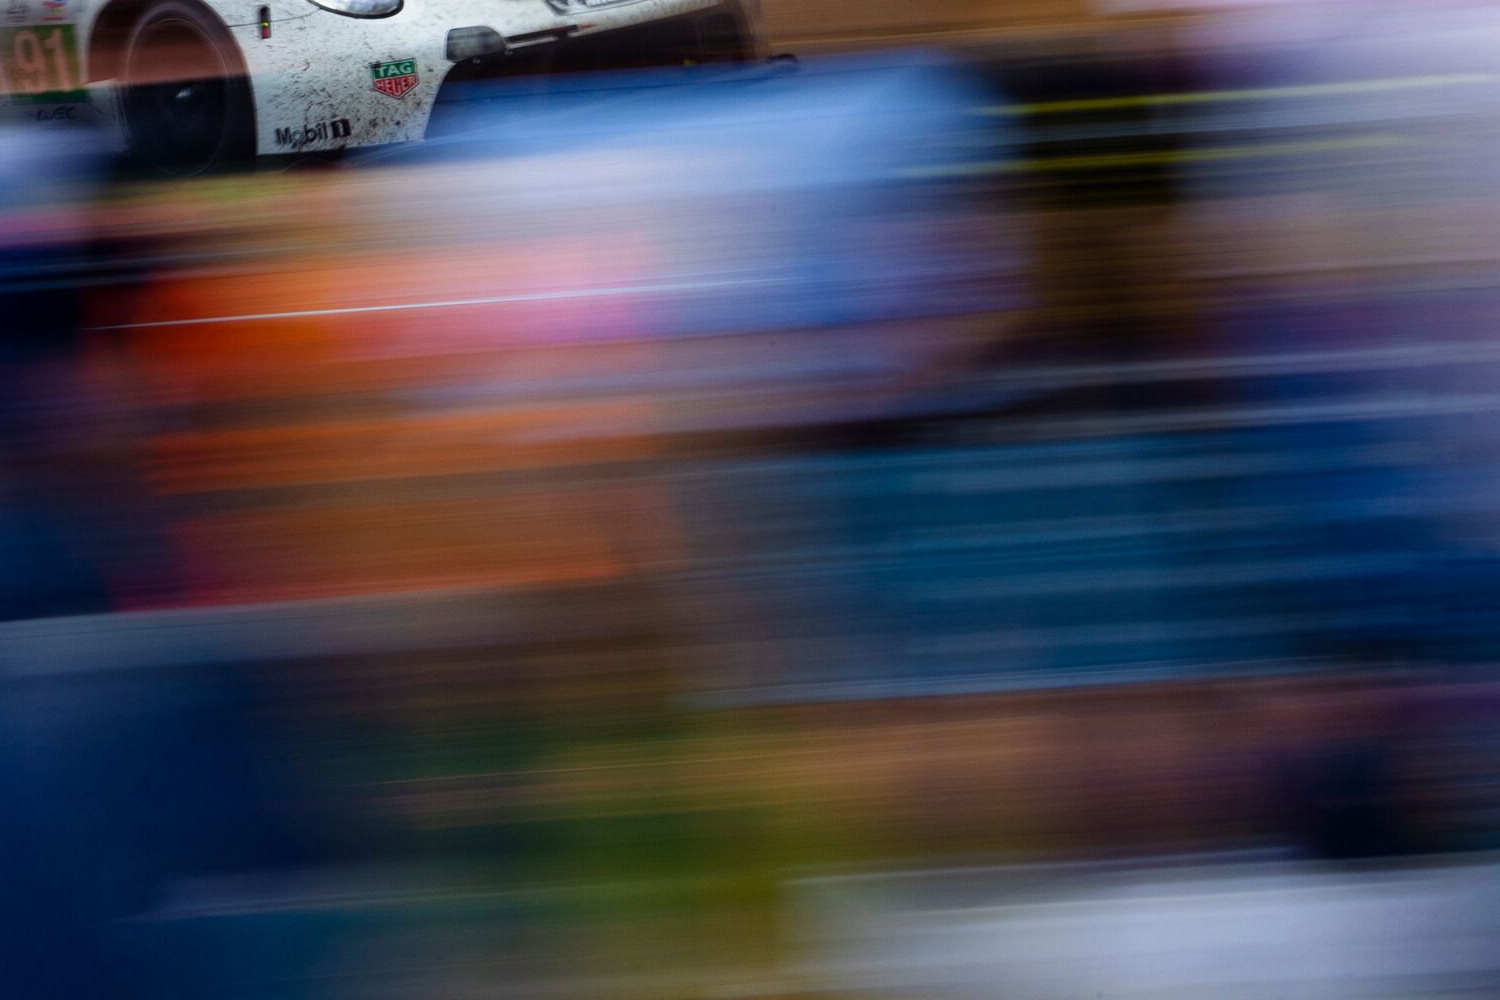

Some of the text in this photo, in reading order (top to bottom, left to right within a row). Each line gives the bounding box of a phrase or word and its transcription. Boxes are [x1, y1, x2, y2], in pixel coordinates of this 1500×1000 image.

[12, 27, 73, 94] 91
[377, 62, 413, 77] TAG
[375, 77, 417, 96] HEUER
[275, 121, 328, 147] Mobil
